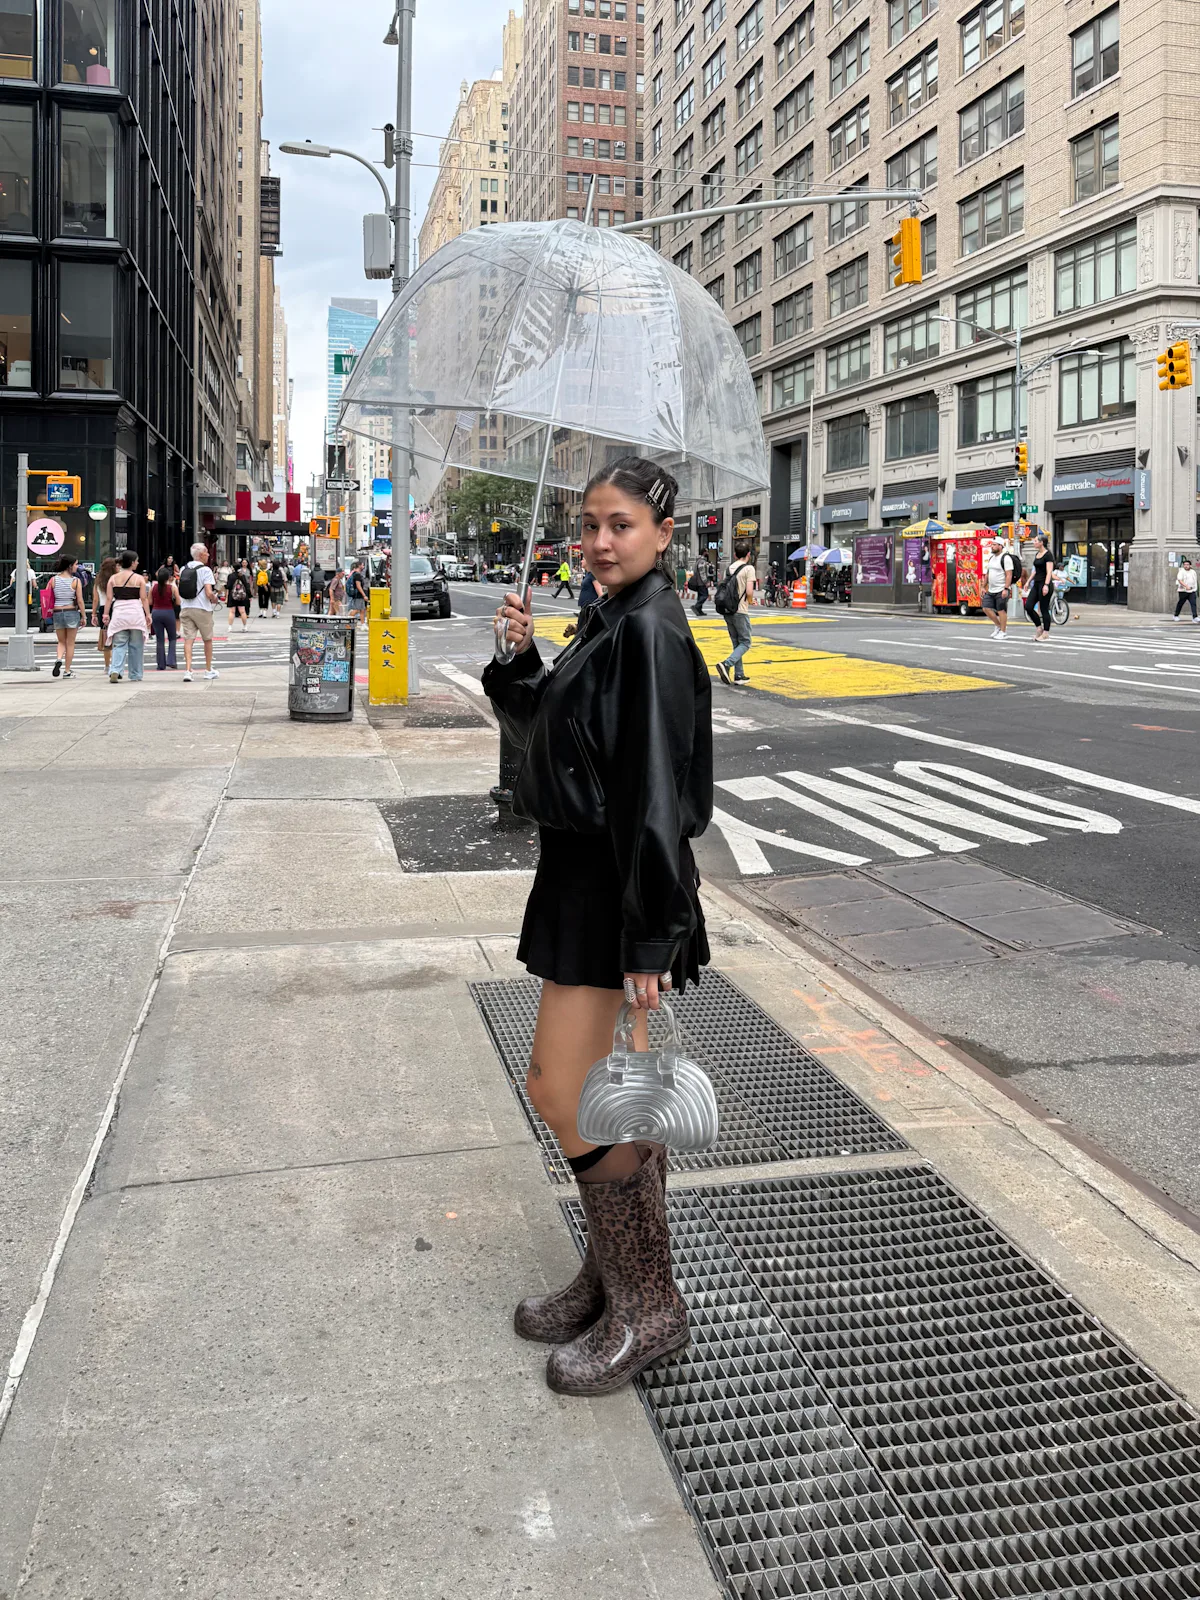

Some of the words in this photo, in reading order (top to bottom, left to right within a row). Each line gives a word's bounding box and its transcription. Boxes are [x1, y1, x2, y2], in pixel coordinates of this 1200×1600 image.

[341, 356, 351, 372] W
[1096, 477, 1131, 490] Walgreens
[831, 508, 852, 519] pharmacy
